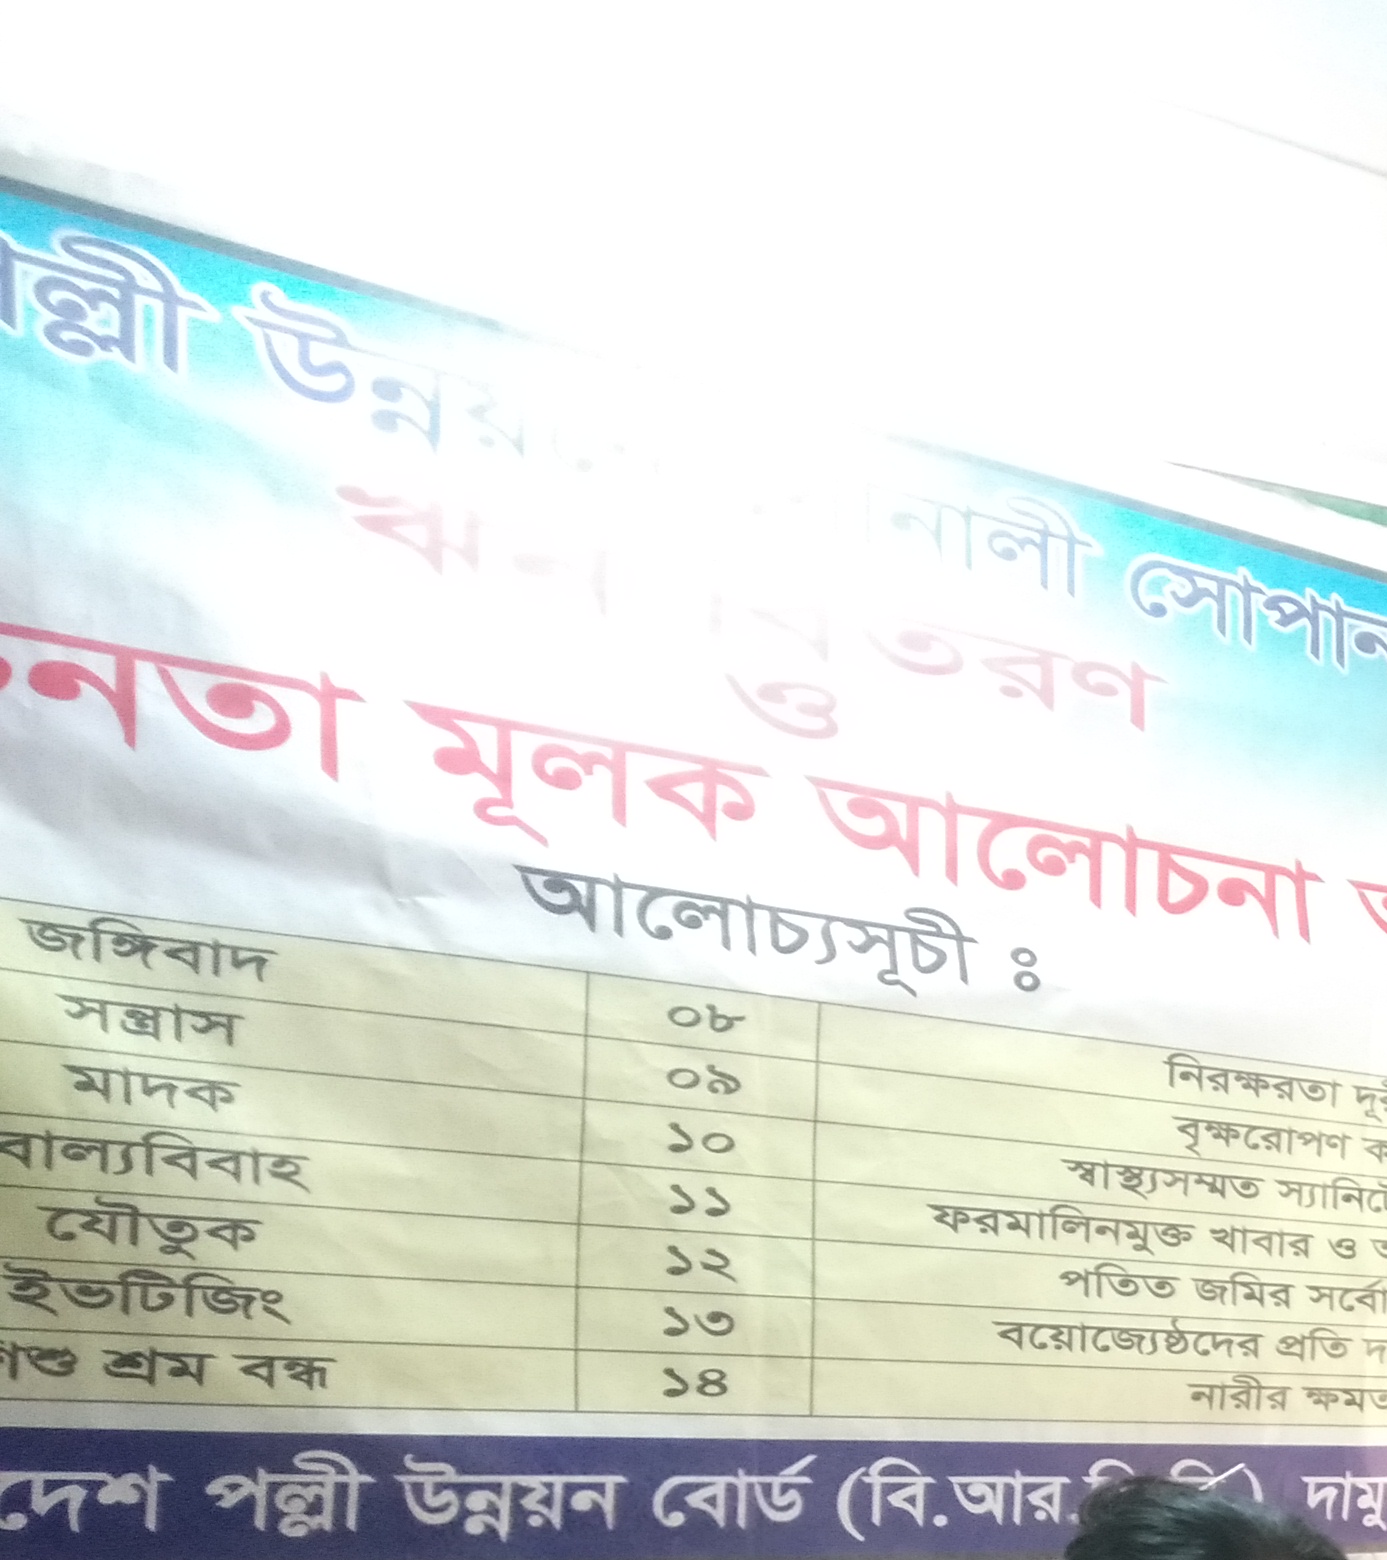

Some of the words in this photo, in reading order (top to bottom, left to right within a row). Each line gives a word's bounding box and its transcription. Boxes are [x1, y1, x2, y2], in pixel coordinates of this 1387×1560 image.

[727, 674, 839, 739] ও
[0, 622, 366, 782] নতা
[403, 700, 770, 848] মূলক
[805, 776, 1324, 944] আলোচনা
[18, 916, 278, 982] জঙ্গিবাদ
[512, 864, 978, 997] আলোচ্যসূচী
[55, 993, 245, 1046] সন্ত্রাস
[667, 1003, 746, 1033] ০৮
[61, 1063, 242, 1112] মাদক
[666, 1064, 742, 1096] ০৯
[1163, 1053, 1343, 1108] নিরক্ষরতা
[668, 1122, 735, 1154] ১০
[1171, 1116, 1352, 1160] বৃক্ষরোপণ
[0, 1130, 311, 1193] বাল্যবিবাহ
[1060, 1159, 1264, 1200] স্বাস্থ্যসম্মত
[669, 1184, 731, 1217] ১১
[37, 1196, 263, 1260] যৌতুক
[927, 1203, 1195, 1255] ফরমালিনমুক্ত
[1209, 1224, 1314, 1258] খাবার
[1327, 1237, 1357, 1260] ও
[666, 1245, 738, 1283] ১২
[1059, 1262, 1182, 1298] পতিত
[1191, 1271, 1296, 1308] জমির
[0, 1262, 291, 1324] ইভটিজিং
[663, 1306, 735, 1337] ১৩
[991, 1317, 1265, 1359] বয়োজ্যেষ্ঠদের
[1276, 1327, 1353, 1361] প্রতি
[102, 1346, 218, 1387] শ্রম
[231, 1353, 337, 1389] বন্ধ
[662, 1368, 728, 1398] ১৪
[1187, 1375, 1292, 1411] নারীর
[205, 1450, 377, 1538] পল্লী
[394, 1454, 629, 1543] উন্নয়ন
[652, 1454, 818, 1530] বোর্ড
